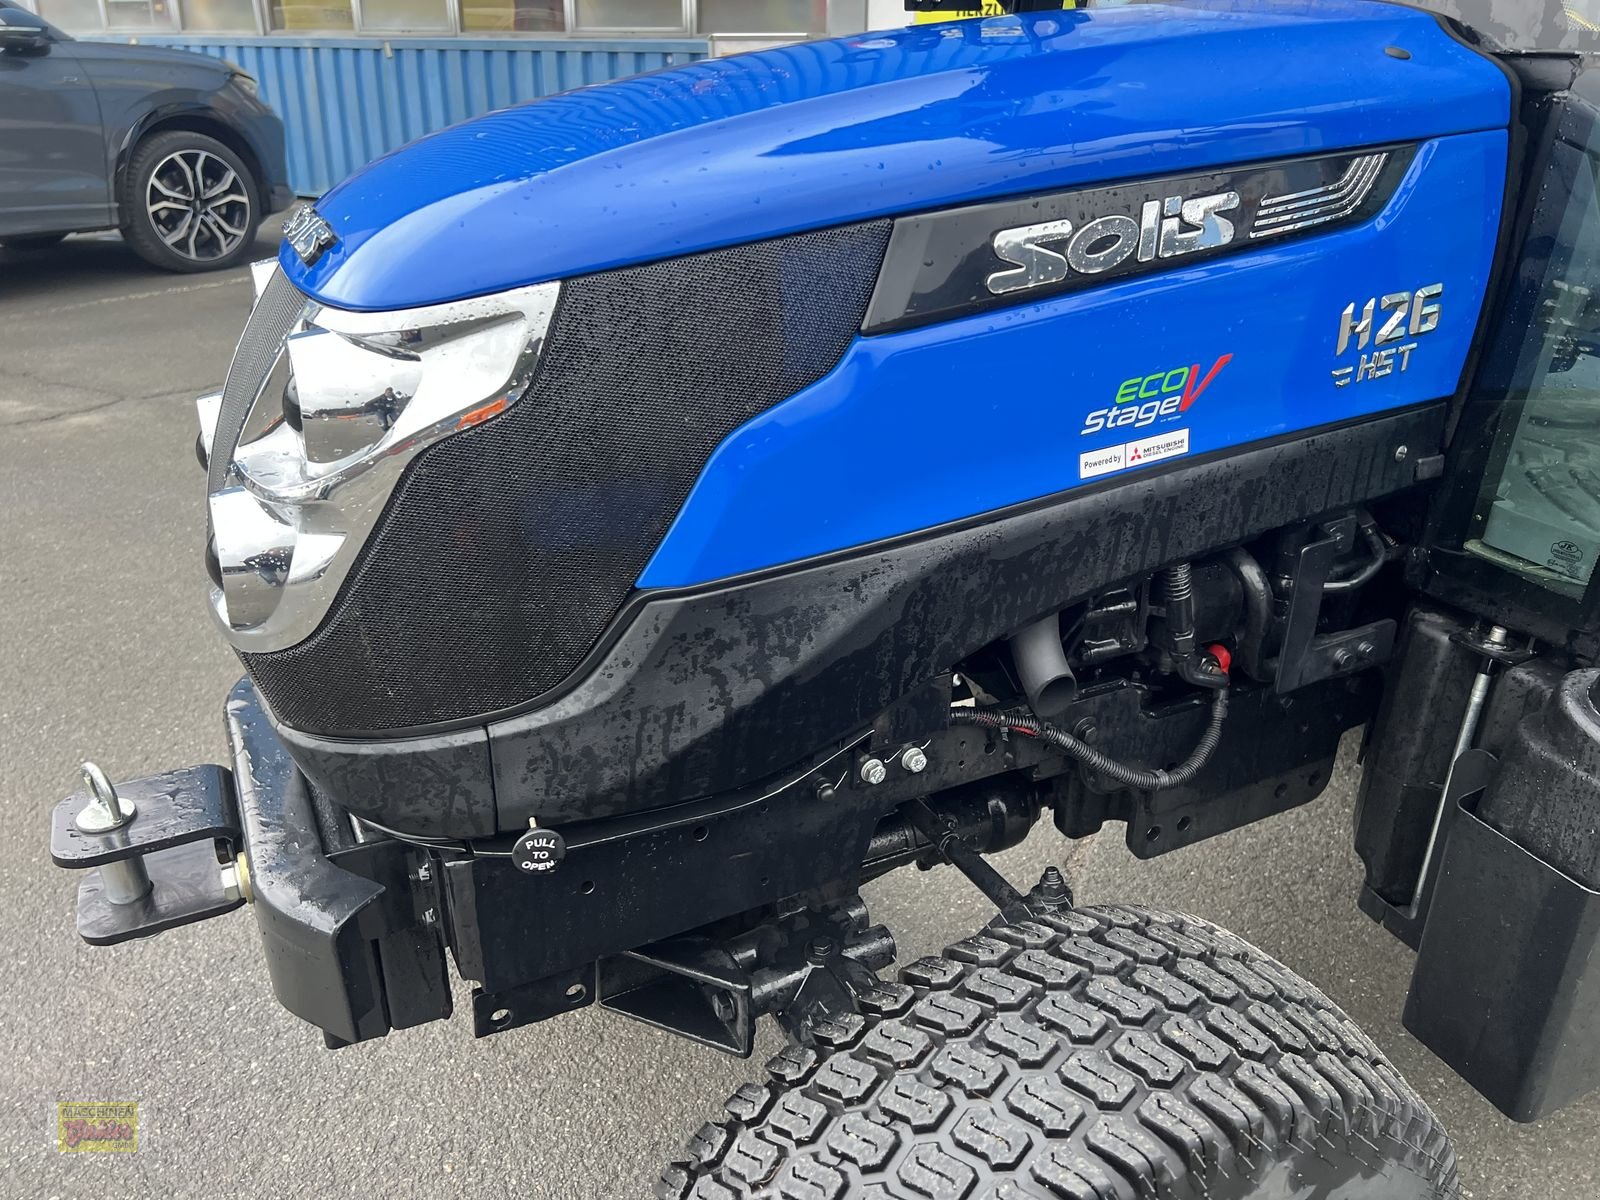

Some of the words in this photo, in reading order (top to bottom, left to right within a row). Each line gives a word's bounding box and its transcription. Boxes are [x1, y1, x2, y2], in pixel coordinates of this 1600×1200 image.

[1335, 282, 1443, 357] H26
[1355, 341, 1418, 383] HST
[1115, 366, 1190, 404] ECO
[1080, 395, 1182, 435] Stage
[1178, 353, 1234, 412] V
[1143, 438, 1185, 454] MITSUBISHI
[1084, 455, 1113, 469] Powered
[1113, 454, 1122, 463] by
[525, 838, 556, 850] PULL
[532, 851, 549, 859] TO
[521, 860, 556, 870] OPEN
